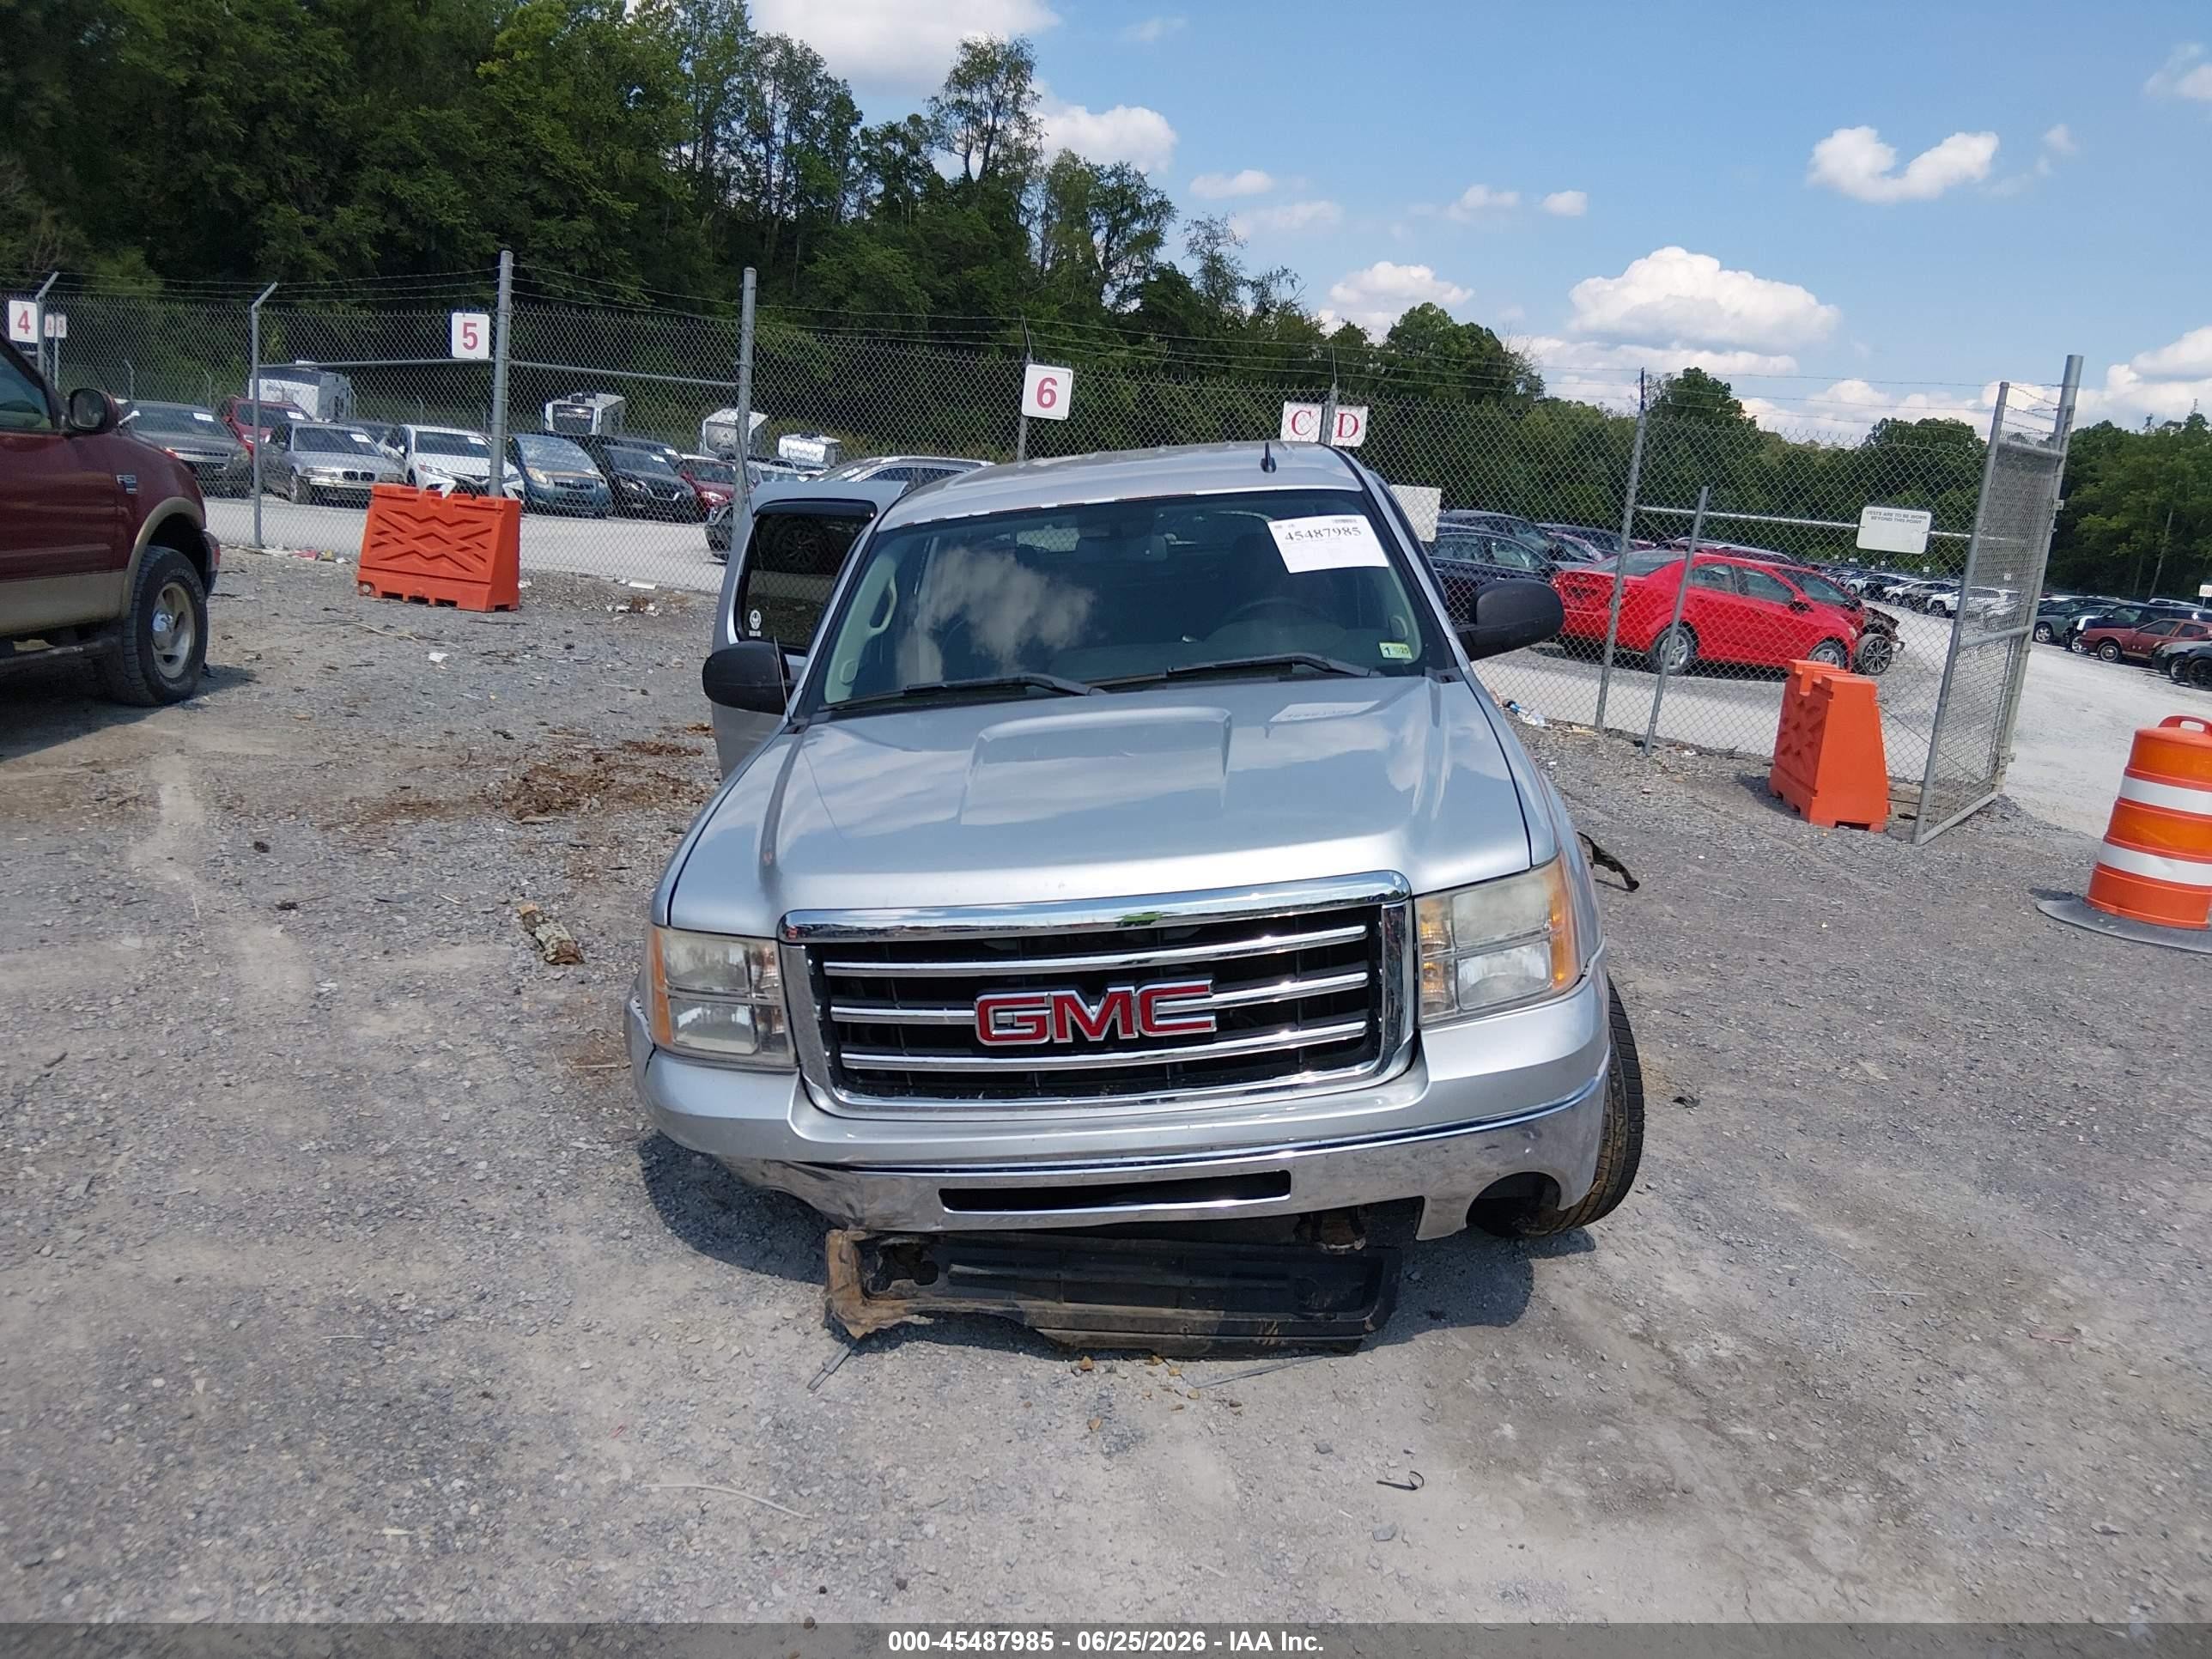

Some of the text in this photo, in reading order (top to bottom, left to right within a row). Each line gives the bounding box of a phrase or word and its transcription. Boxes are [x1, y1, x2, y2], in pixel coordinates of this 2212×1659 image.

[17, 309, 31, 335] 4
[462, 322, 478, 350] 5
[1036, 377, 1058, 409] 6
[1291, 410, 1312, 436] C
[1335, 412, 1359, 439] D
[1285, 526, 1362, 543] 45487985
[975, 978, 1218, 1048] GMC
